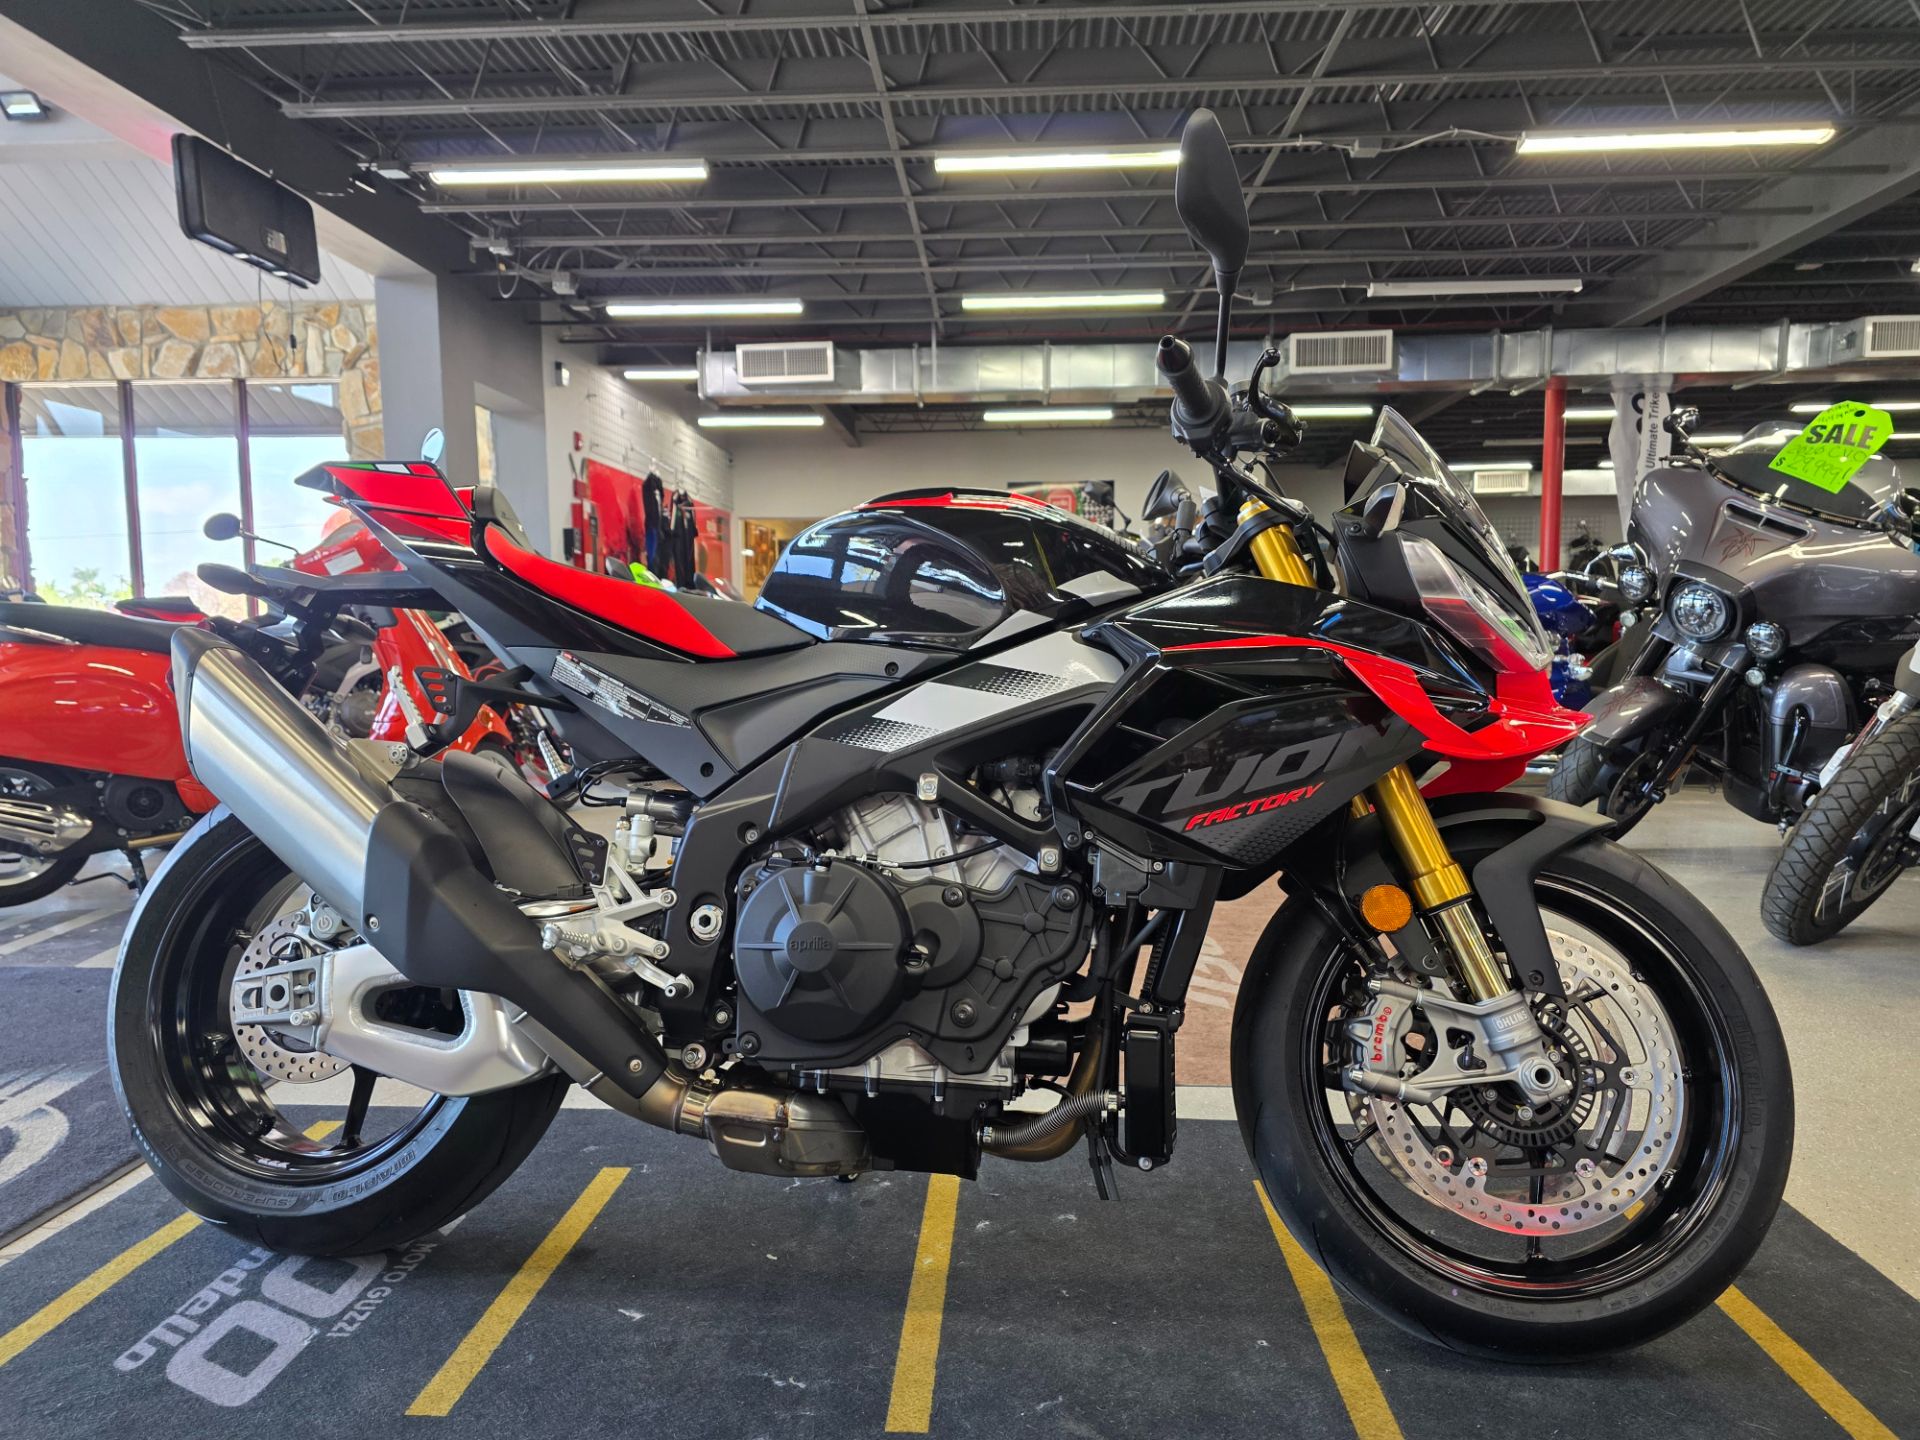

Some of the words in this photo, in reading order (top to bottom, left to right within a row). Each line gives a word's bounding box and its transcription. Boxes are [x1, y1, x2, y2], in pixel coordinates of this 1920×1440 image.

[1645, 423, 1659, 470] Ultimate
[1806, 423, 1879, 450] SALE
[1102, 716, 1410, 816] TUON
[1184, 780, 1326, 832] FACTORY
[790, 935, 830, 953] aprilia
[1370, 1006, 1393, 1064] brembo
[383, 1244, 438, 1284] MOTO
[113, 1246, 274, 1372] ndello
[326, 1286, 393, 1337] GUZZI
